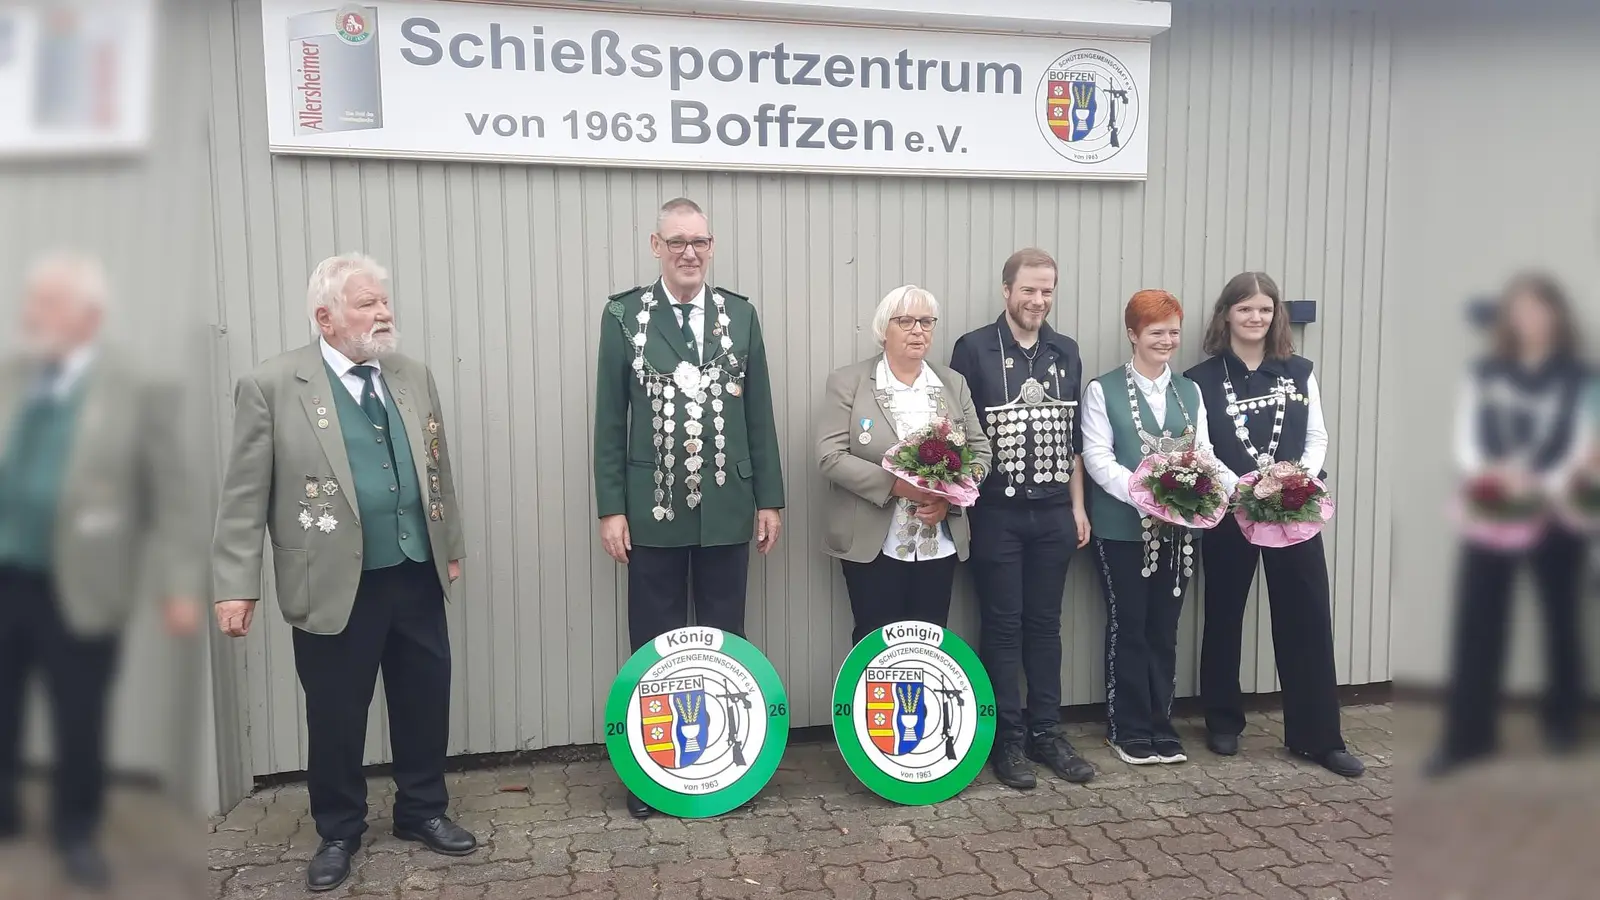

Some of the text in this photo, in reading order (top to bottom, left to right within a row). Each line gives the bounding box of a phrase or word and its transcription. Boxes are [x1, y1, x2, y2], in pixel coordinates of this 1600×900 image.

[400, 17, 1023, 95] Schießsportzentrum
[1049, 71, 1095, 82] BOFFZEN
[297, 41, 323, 131] Allersheimer
[465, 100, 968, 153] von 1963 Boffzen e.V.
[666, 630, 714, 647] König
[885, 625, 941, 642] Königin
[652, 653, 748, 679] SCHÜTZENGEMEINSCHAFT
[878, 647, 963, 680] SCHÜTZENGEMEINSCHAFT
[868, 670, 922, 681] BOFFZEN
[641, 678, 702, 695] BOFFZEN
[834, 703, 995, 717] 20 26
[607, 703, 787, 736] 20 26
[900, 770, 932, 779] von 1963
[701, 780, 719, 790] 1963
